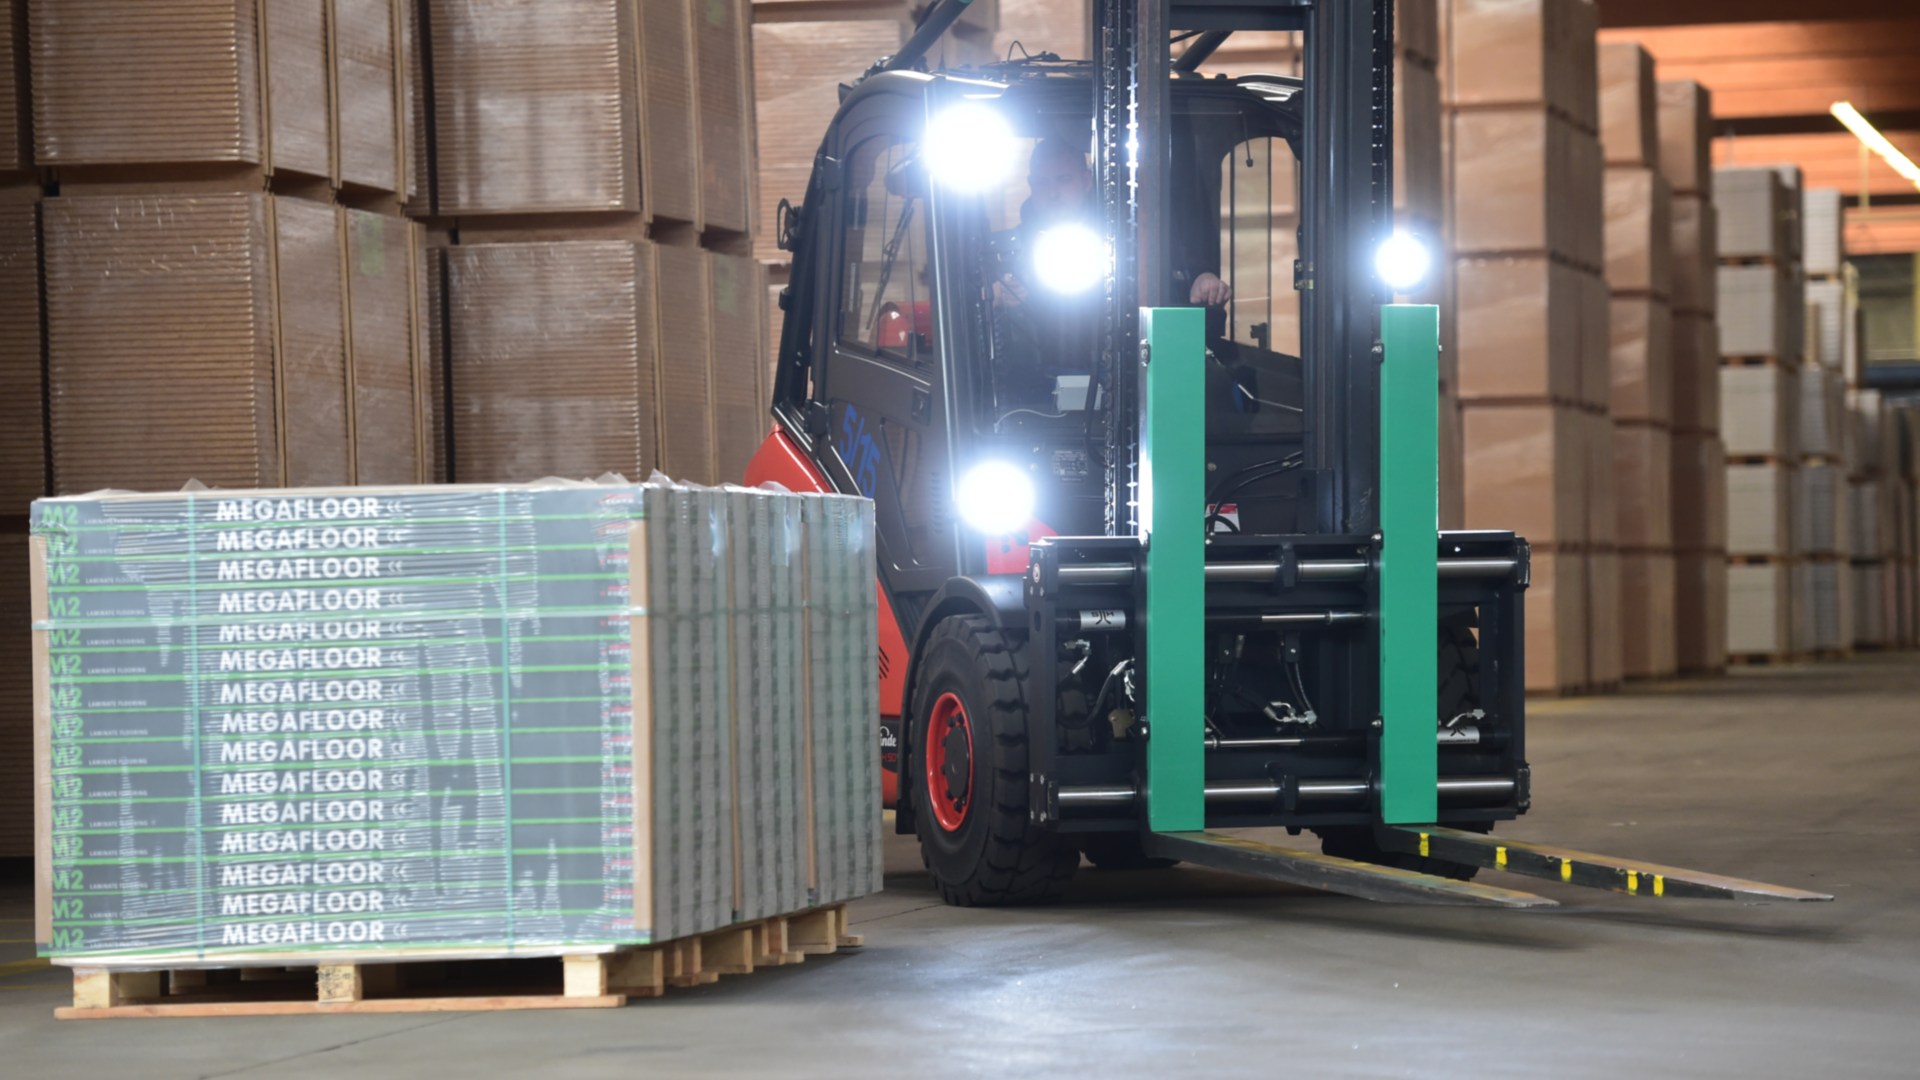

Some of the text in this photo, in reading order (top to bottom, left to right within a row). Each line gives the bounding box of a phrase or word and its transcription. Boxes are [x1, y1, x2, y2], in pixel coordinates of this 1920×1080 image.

[43, 505, 78, 526] M2
[217, 498, 378, 521] MEGAFLOOR
[217, 528, 378, 550] MEGAFLOOR
[218, 557, 379, 580] MEGAFLOOR
[48, 596, 81, 617] M2
[219, 588, 380, 612] MEGAFLOOR
[219, 621, 381, 642] MEGAFLOOR
[220, 647, 381, 671] MEGAFLOOR
[220, 680, 382, 703] MEGAFLOOR
[222, 709, 383, 732] MEGAFLOOR
[221, 738, 383, 762] MEGAFLOOR
[880, 733, 897, 747] inde
[221, 770, 383, 793] MEGAFLOOR
[222, 800, 383, 823] MEGAFLOOR
[221, 829, 384, 853] MEGAFLOOR
[222, 861, 384, 886] MEGAFLOOR
[52, 899, 84, 919] M2
[222, 891, 384, 915] MEGAFLOOR
[48, 928, 84, 949] M2
[222, 920, 385, 944] MEGAFLOOR
